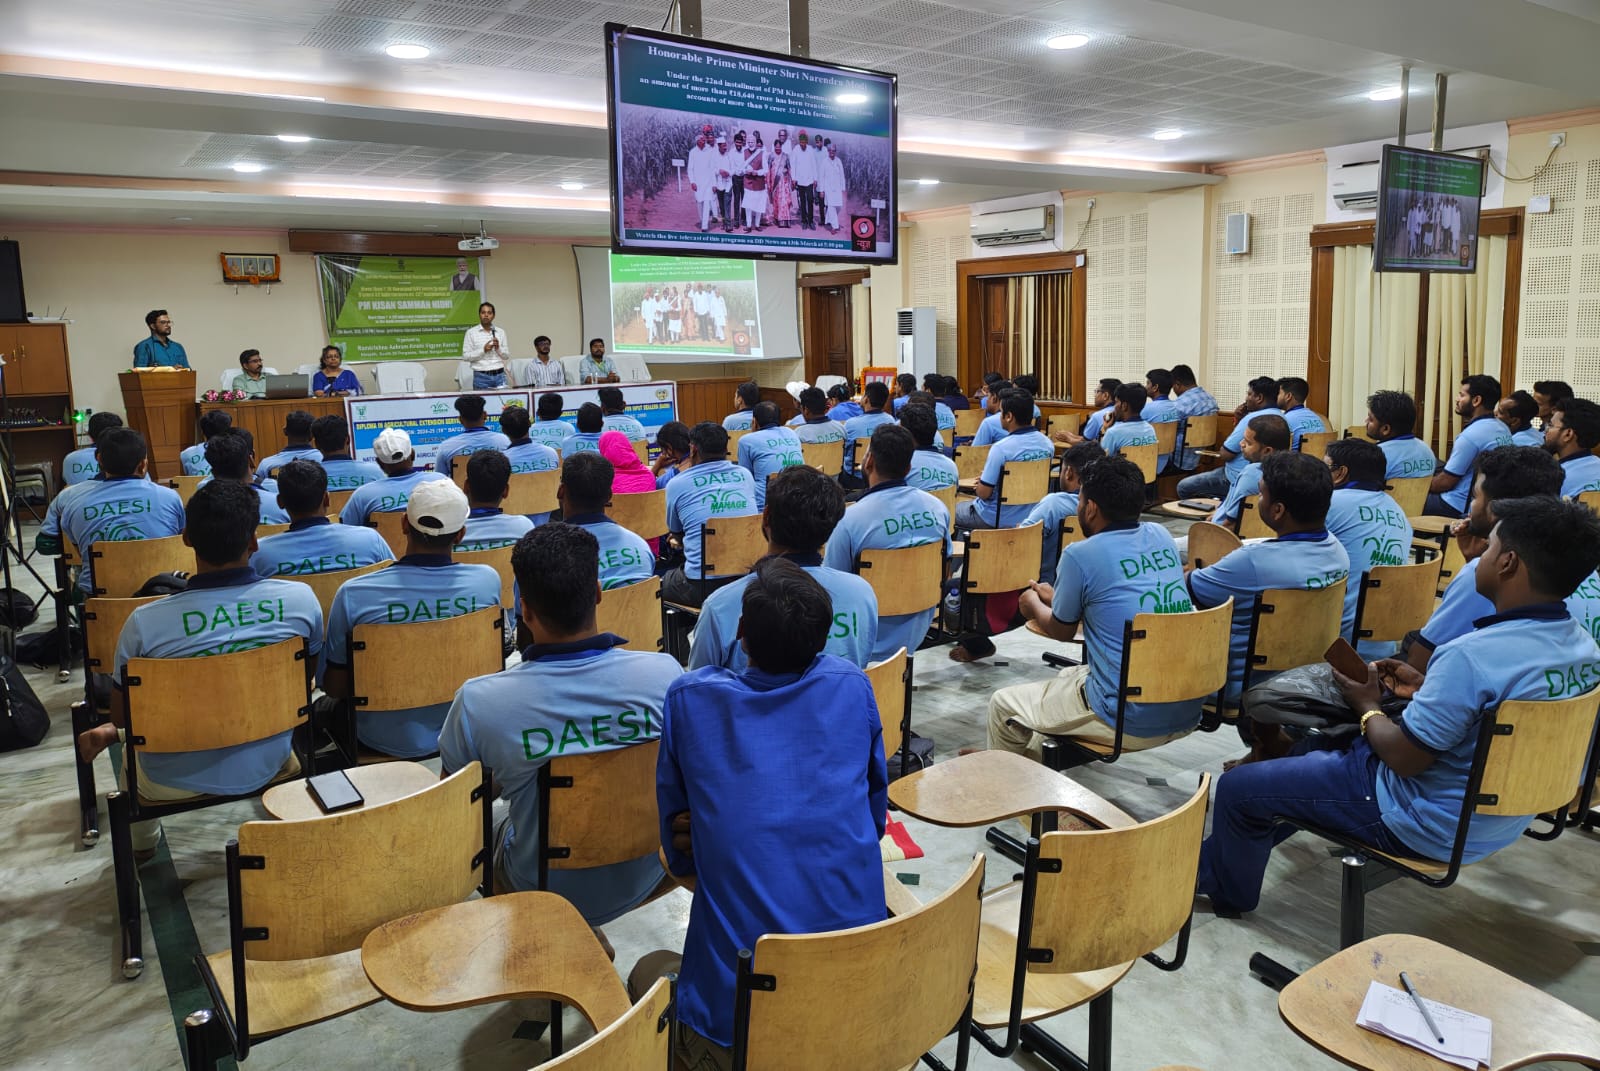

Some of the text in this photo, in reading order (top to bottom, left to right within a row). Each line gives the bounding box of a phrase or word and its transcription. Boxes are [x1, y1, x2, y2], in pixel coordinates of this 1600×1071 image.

[648, 45, 703, 64] Honorable
[706, 55, 737, 69] Prime
[738, 61, 779, 76] Minister
[780, 69, 800, 80] Shri
[651, 79, 680, 89] amount
[690, 85, 709, 93] more
[711, 87, 728, 96] than
[775, 96, 787, 104] has
[788, 97, 803, 107] been
[666, 70, 690, 81] Under
[692, 74, 703, 83] the
[705, 76, 723, 86] 22nd
[724, 78, 762, 92] installment
[772, 87, 784, 96] PM
[785, 89, 805, 99] Kisan
[760, 76, 770, 86] By
[686, 94, 717, 103] accounts
[747, 101, 763, 110] than
[531, 428, 565, 438] DAESI
[327, 475, 364, 487] AESI
[694, 471, 746, 488] DAESI
[84, 499, 151, 521] DAESI
[710, 501, 747, 510] MANAGE
[884, 511, 939, 536] DAESI
[1359, 506, 1406, 532] DAESI
[278, 553, 356, 575] DAESI
[1120, 548, 1178, 580] DAESI
[182, 598, 284, 637] DAESI
[386, 596, 477, 623] DAESI
[1544, 661, 1600, 698] DAES
[521, 706, 652, 761] DAESI
